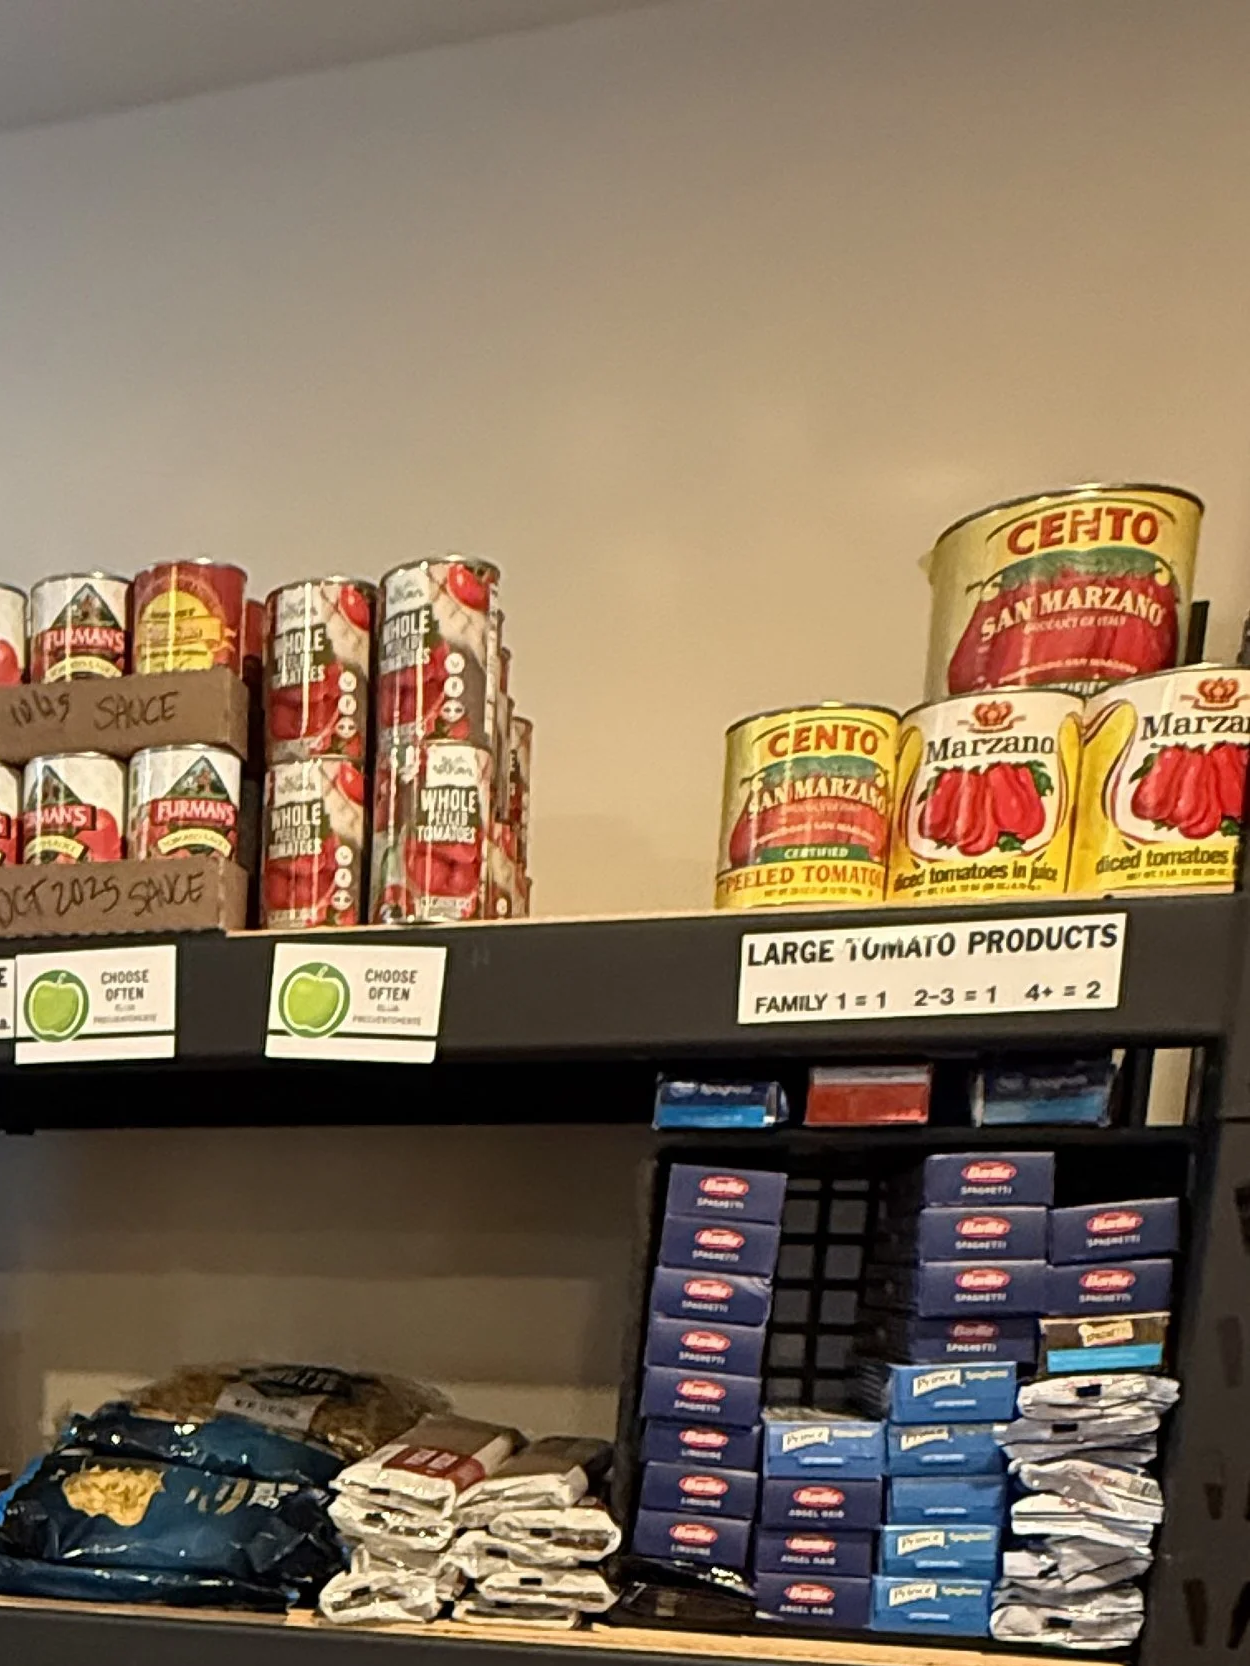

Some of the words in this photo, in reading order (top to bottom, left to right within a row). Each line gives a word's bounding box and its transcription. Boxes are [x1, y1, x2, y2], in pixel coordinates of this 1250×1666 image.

[1007, 507, 1159, 555] CENTO
[981, 597, 1034, 641] SAN
[1040, 585, 1165, 626] MARZANO
[768, 724, 878, 758] CENTO
[925, 735, 1055, 765] Marzano
[421, 789, 478, 811] WHOLE
[929, 864, 1008, 884] tomatoes
[1013, 861, 1026, 879] in
[1096, 848, 1141, 875] diced
[1146, 847, 1228, 867] tomatoes
[726, 865, 795, 893] PEELED
[52, 874, 121, 917] 2025
[747, 940, 834, 967] LARGE
[844, 932, 956, 961] TOMATO
[968, 923, 1118, 955] PRODUCTS
[100, 968, 149, 985] CHOOSE
[364, 968, 418, 985] CHOOSE
[105, 987, 144, 1001] OFTEN
[369, 986, 410, 1001] OFTEN
[755, 993, 827, 1014] FAMILY
[836, 992, 846, 1010] 1
[876, 991, 886, 1009] 1
[914, 988, 954, 1008] 2-3
[987, 986, 997, 1004] 1
[1024, 983, 1052, 1000] 4+
[1086, 981, 1102, 999] 2
